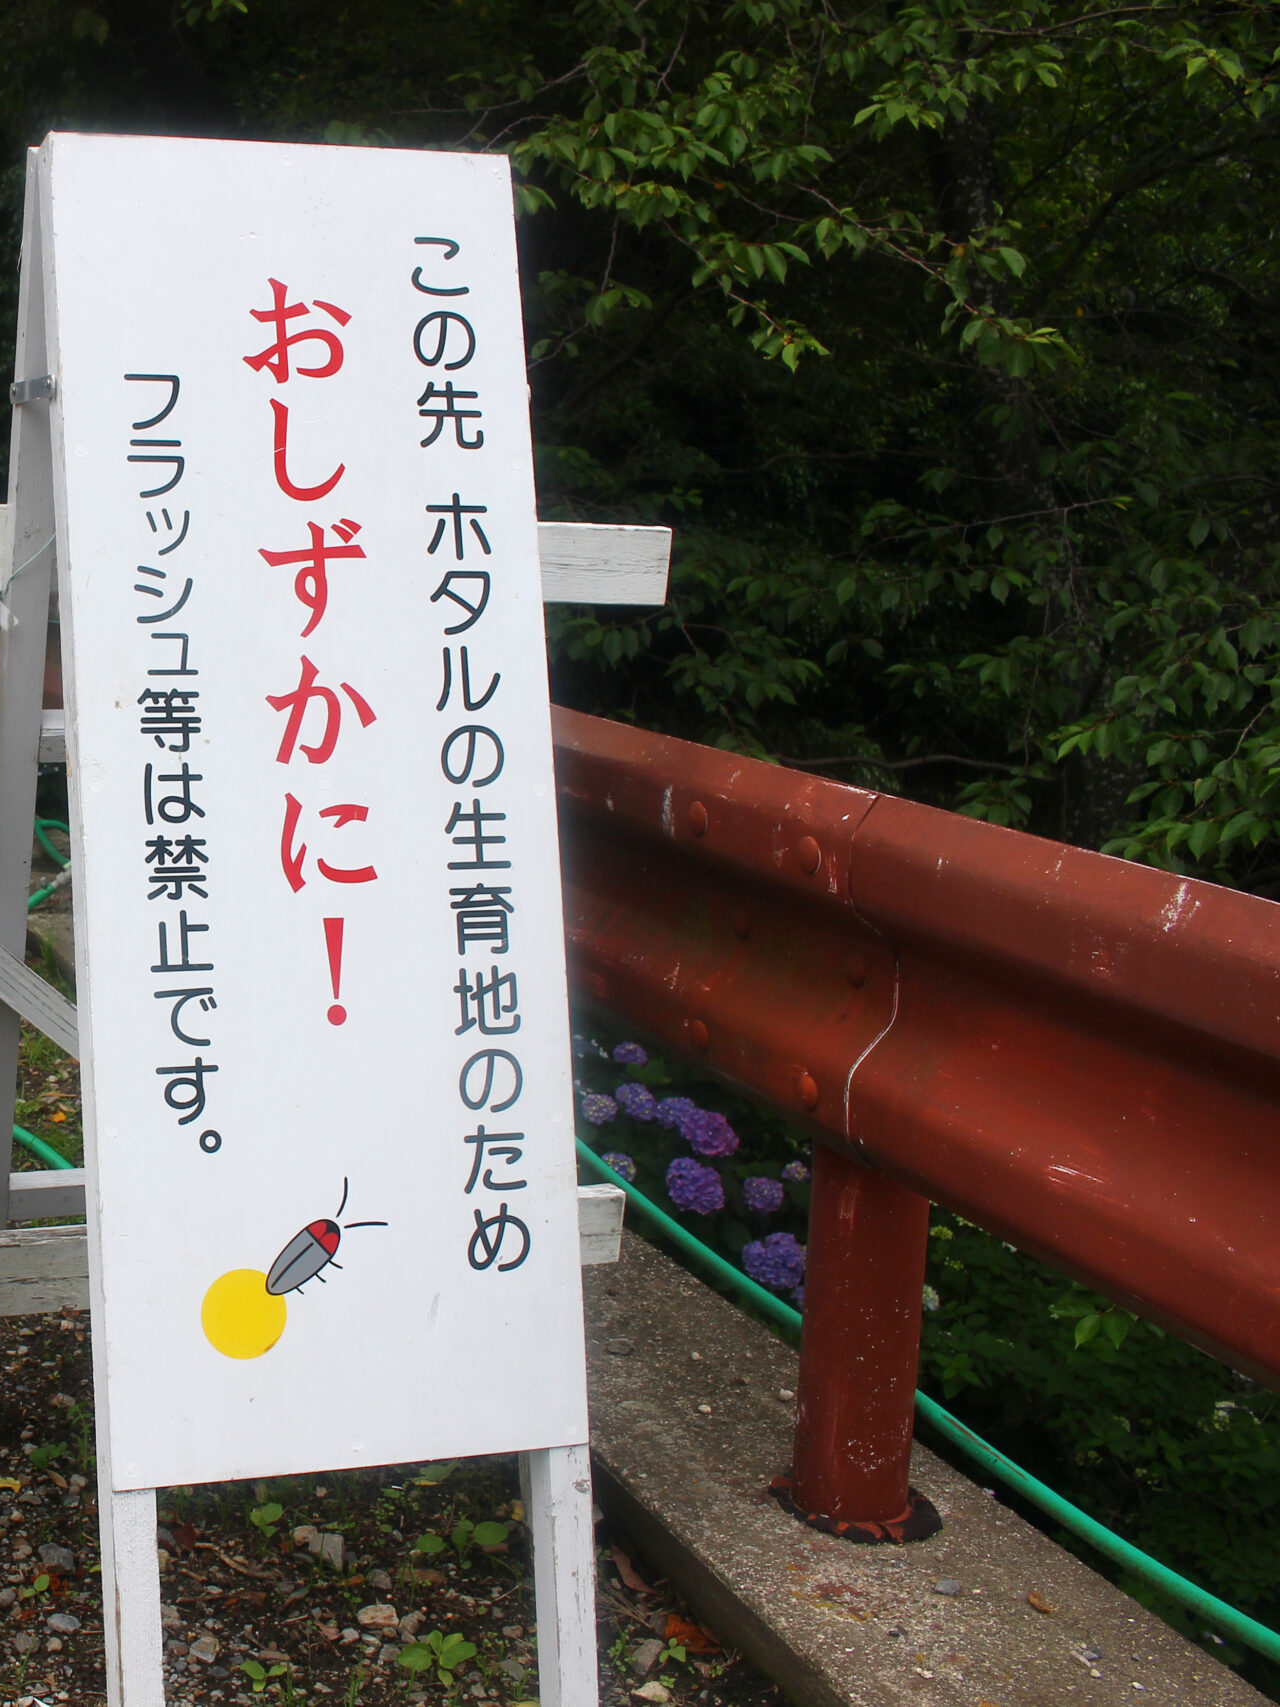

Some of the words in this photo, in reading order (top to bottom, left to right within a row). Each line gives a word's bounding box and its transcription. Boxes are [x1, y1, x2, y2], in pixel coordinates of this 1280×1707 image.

[242, 277, 378, 1026] おしずかに！
[411, 236, 485, 449] この先
[123, 374, 222, 1153] フラッシュ等は禁止です。
[425, 492, 531, 1273] ホタルの生育地のため
